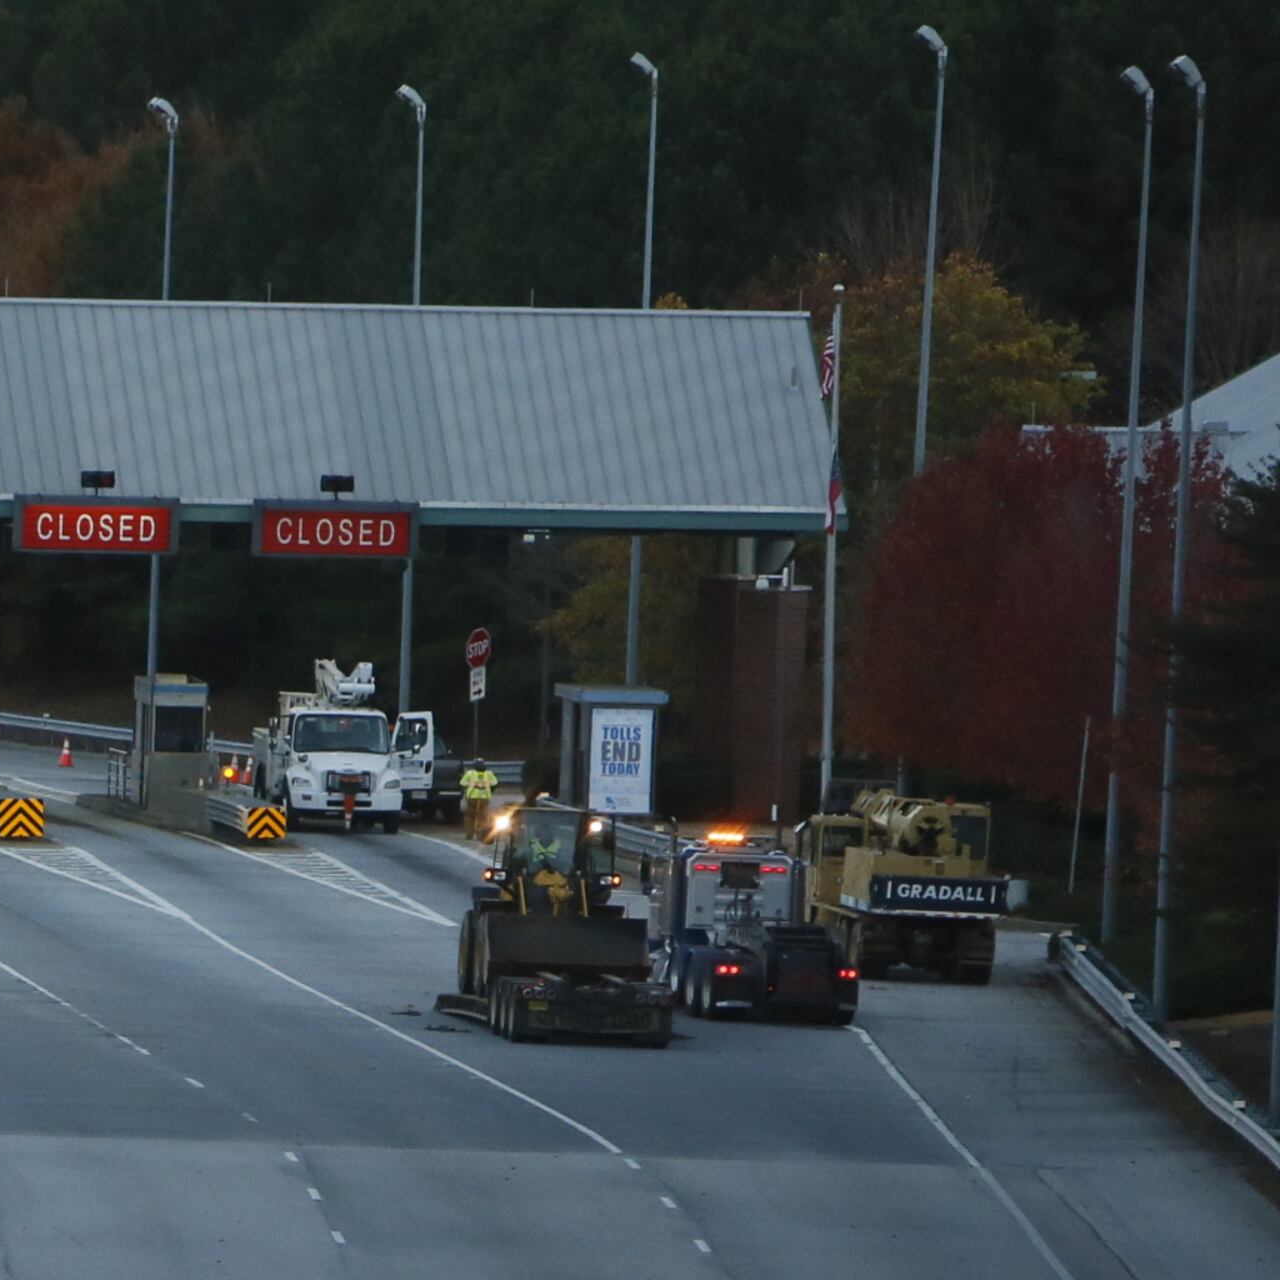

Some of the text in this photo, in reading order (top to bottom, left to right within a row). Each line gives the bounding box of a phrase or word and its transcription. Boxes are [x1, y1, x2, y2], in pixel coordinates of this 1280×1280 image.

[37, 513, 156, 542] CLOSED
[277, 517, 396, 546] CLOSED
[468, 639, 488, 659] STOP
[602, 726, 642, 740] TOLLS
[601, 741, 641, 762] END
[601, 762, 640, 775] TODAY
[897, 883, 985, 902] GRADALL
